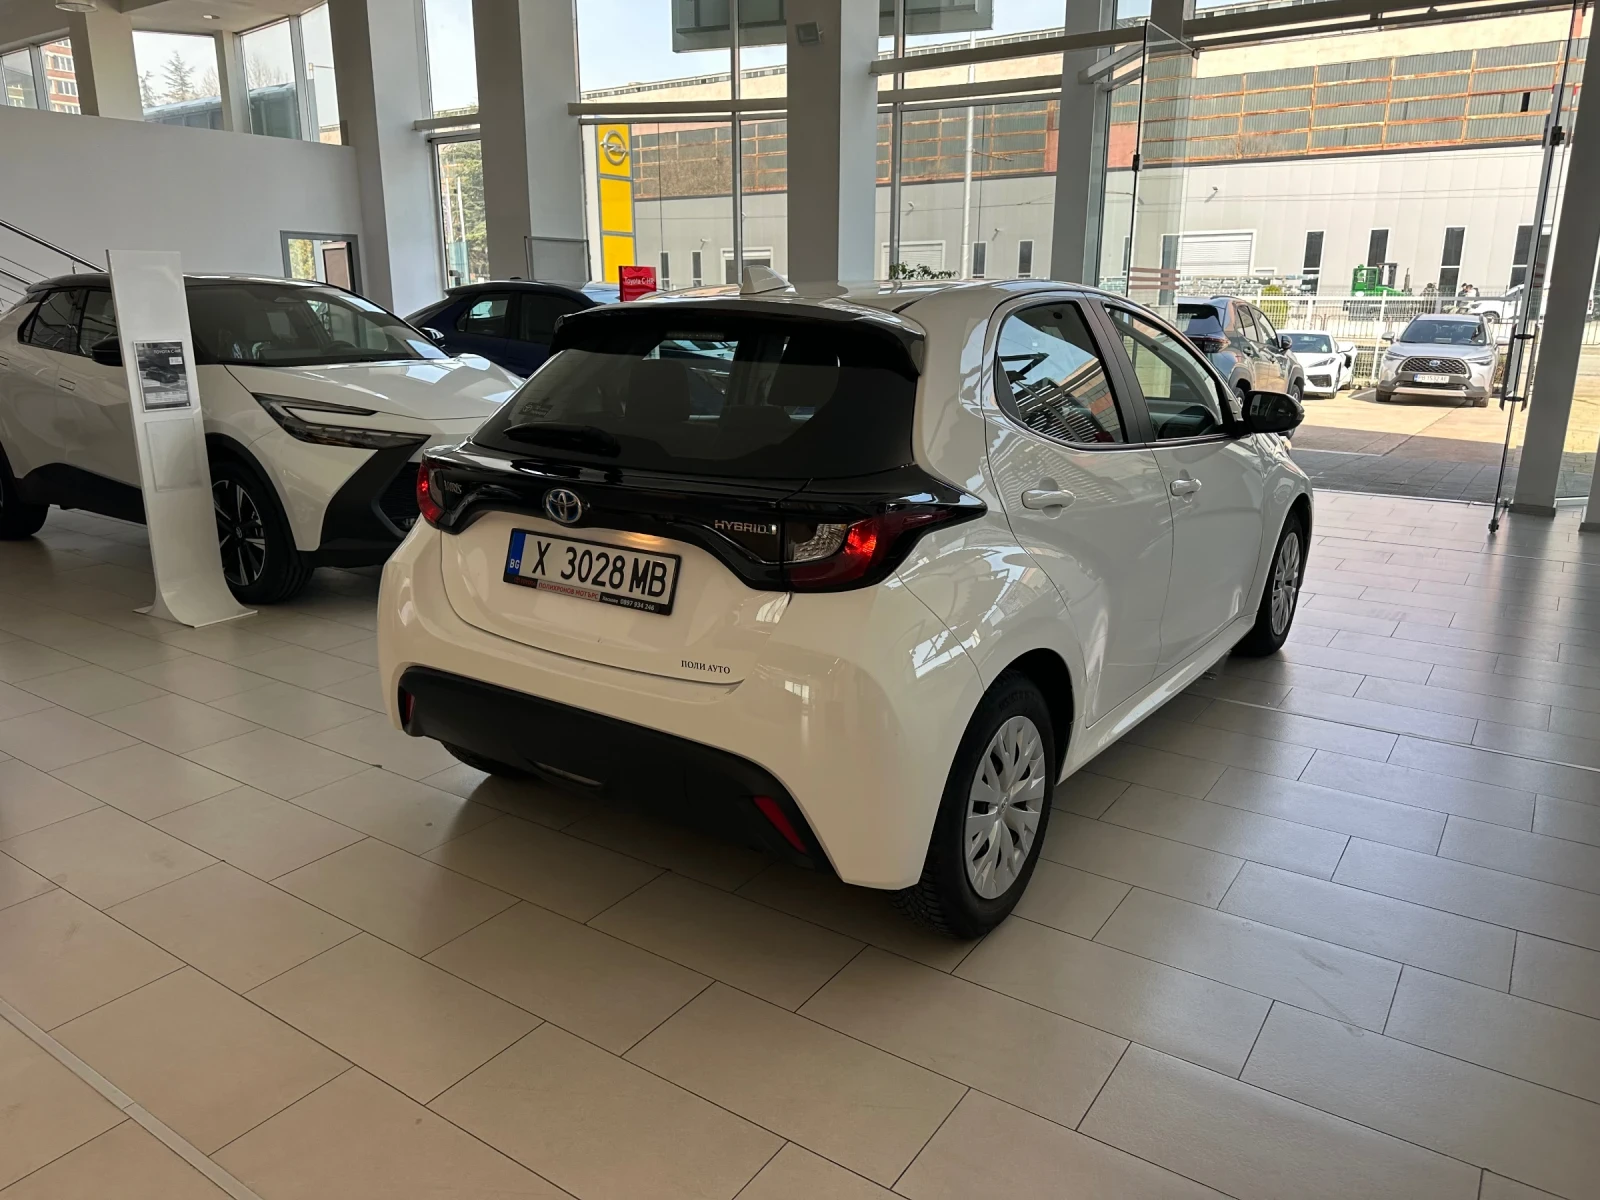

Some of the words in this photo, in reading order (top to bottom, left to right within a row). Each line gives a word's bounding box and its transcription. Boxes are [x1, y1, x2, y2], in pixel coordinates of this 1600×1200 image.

[624, 277, 641, 285] Toyota
[509, 558, 520, 570] BG
[560, 546, 626, 590] 3028
[538, 582, 575, 594] ПОЛИХРОНОВ
[575, 589, 599, 600] МОТЪРС
[633, 601, 644, 609] 934
[681, 659, 706, 671] ПОЛИ
[707, 664, 731, 675] АУТО
